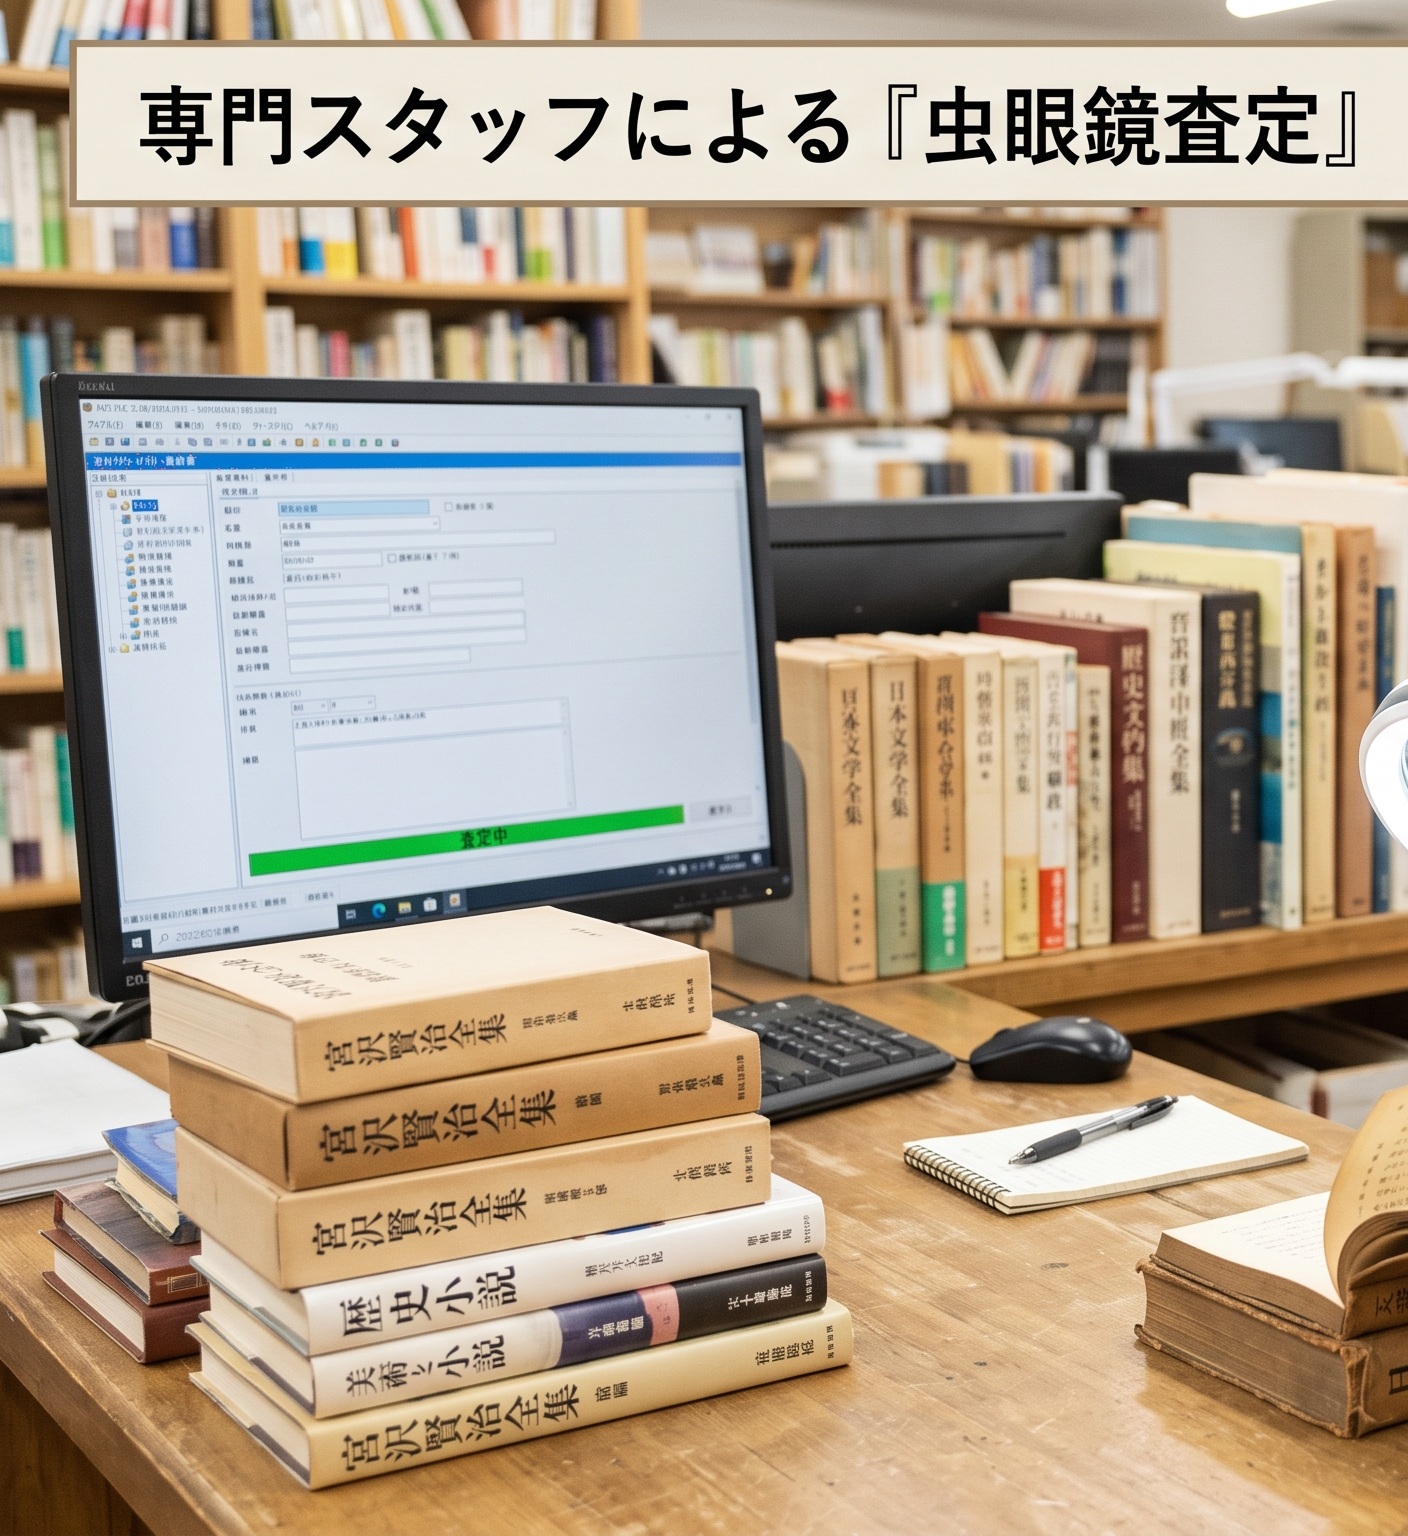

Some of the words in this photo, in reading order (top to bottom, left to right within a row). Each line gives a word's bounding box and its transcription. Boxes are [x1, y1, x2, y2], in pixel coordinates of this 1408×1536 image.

[324, 1013, 508, 1072] 宮沢賢治全集
[319, 1089, 557, 1163] 宮沢賢治全集
[312, 1188, 528, 1256] 宮沢賢治全集
[340, 1265, 519, 1337] 歴史小説
[341, 1383, 581, 1472] 宮沢賢治全集
